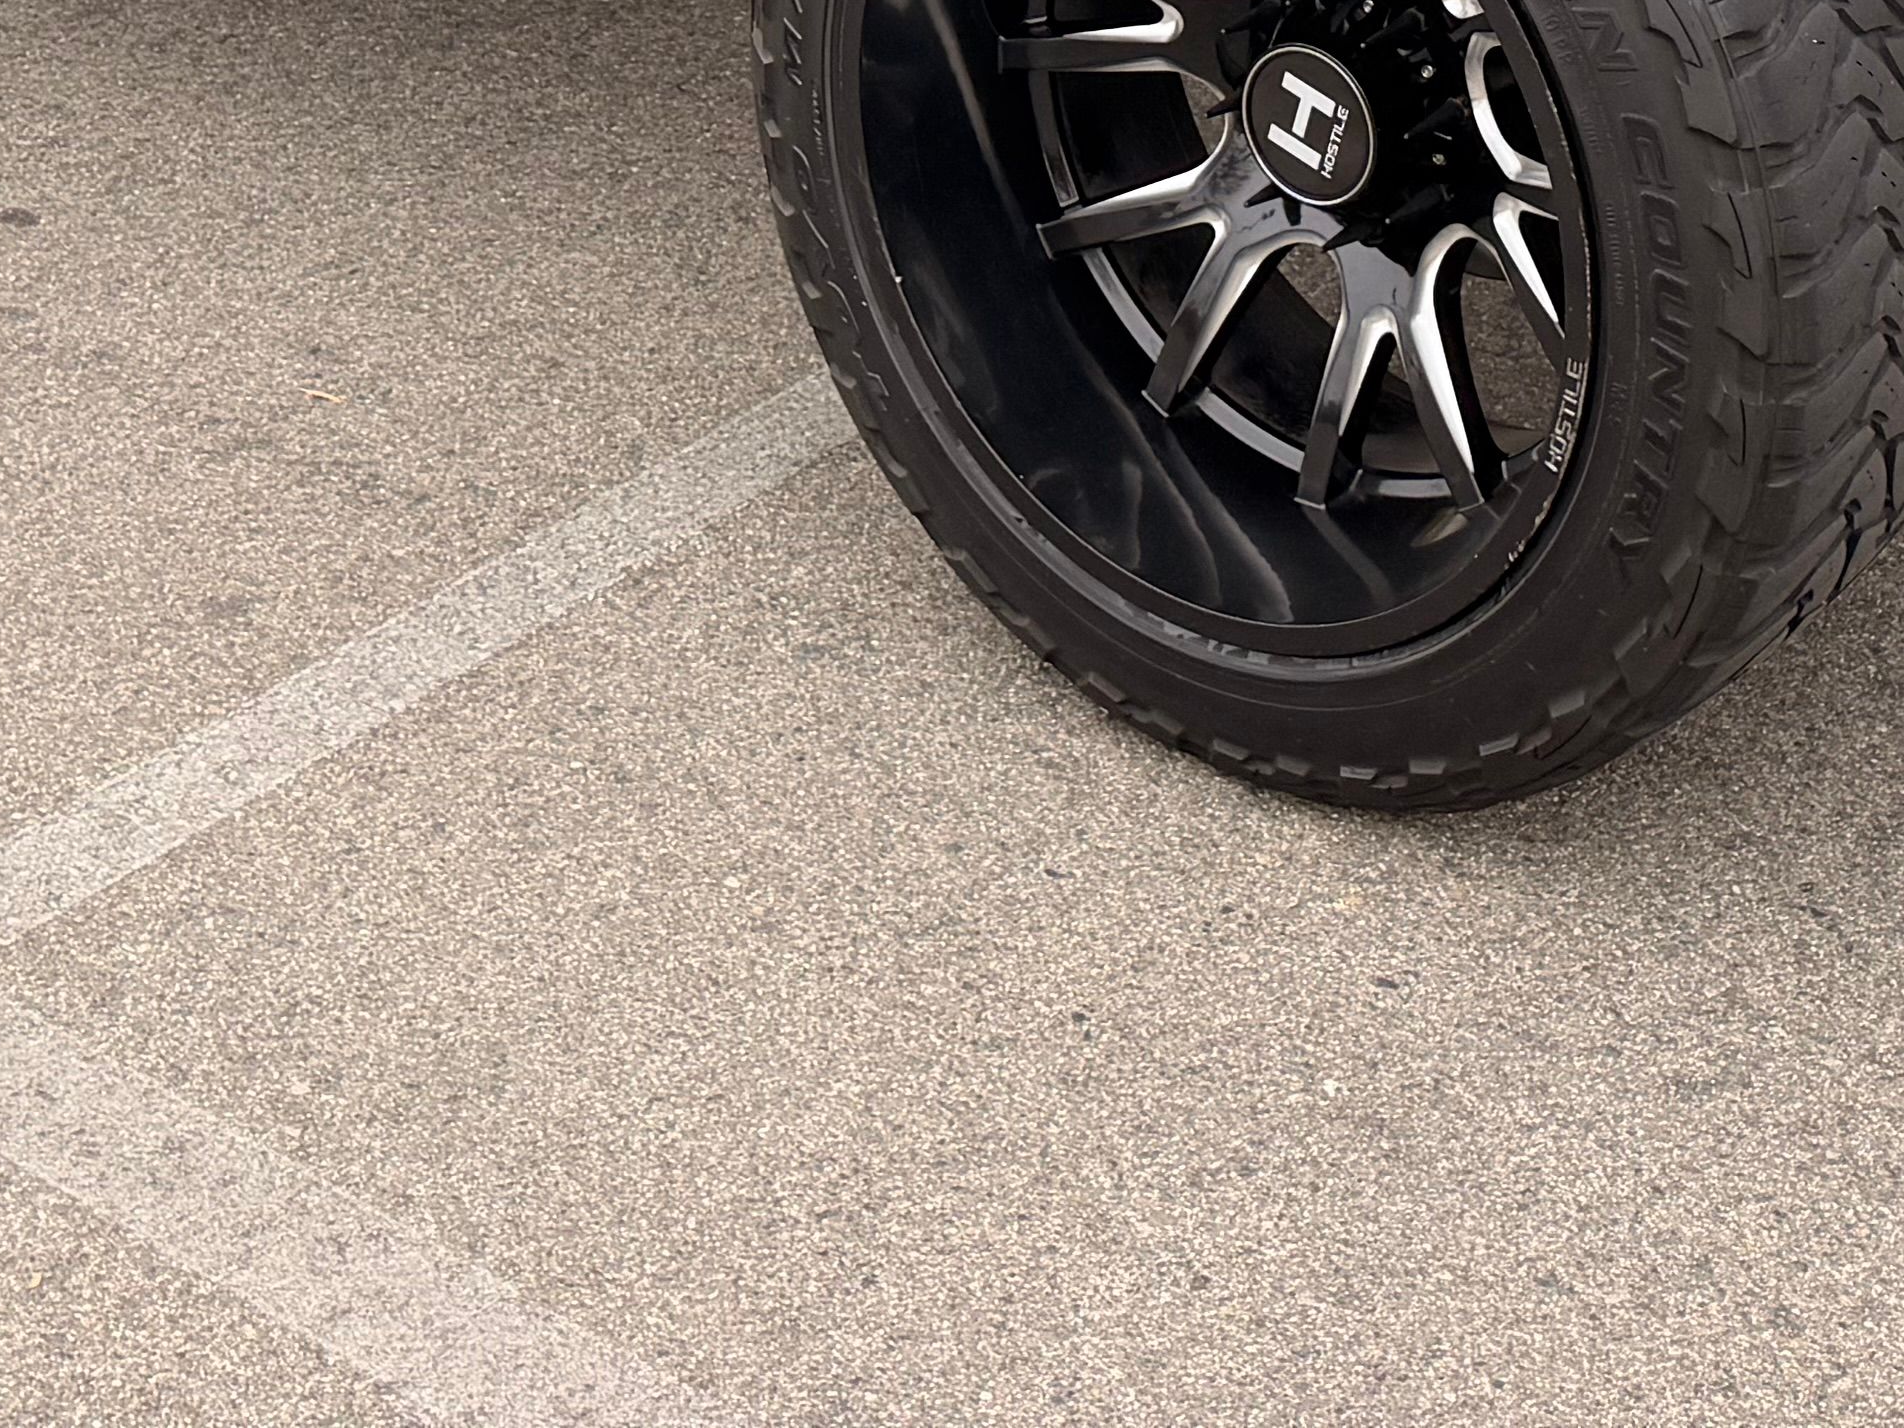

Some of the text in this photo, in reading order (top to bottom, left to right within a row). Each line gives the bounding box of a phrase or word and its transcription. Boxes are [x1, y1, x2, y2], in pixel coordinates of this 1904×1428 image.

[1266, 69, 1337, 172] H
[1319, 104, 1351, 180] HOSTILE
[1606, 111, 1696, 590] COUNTRY
[1543, 356, 1586, 474] HOSTILE
